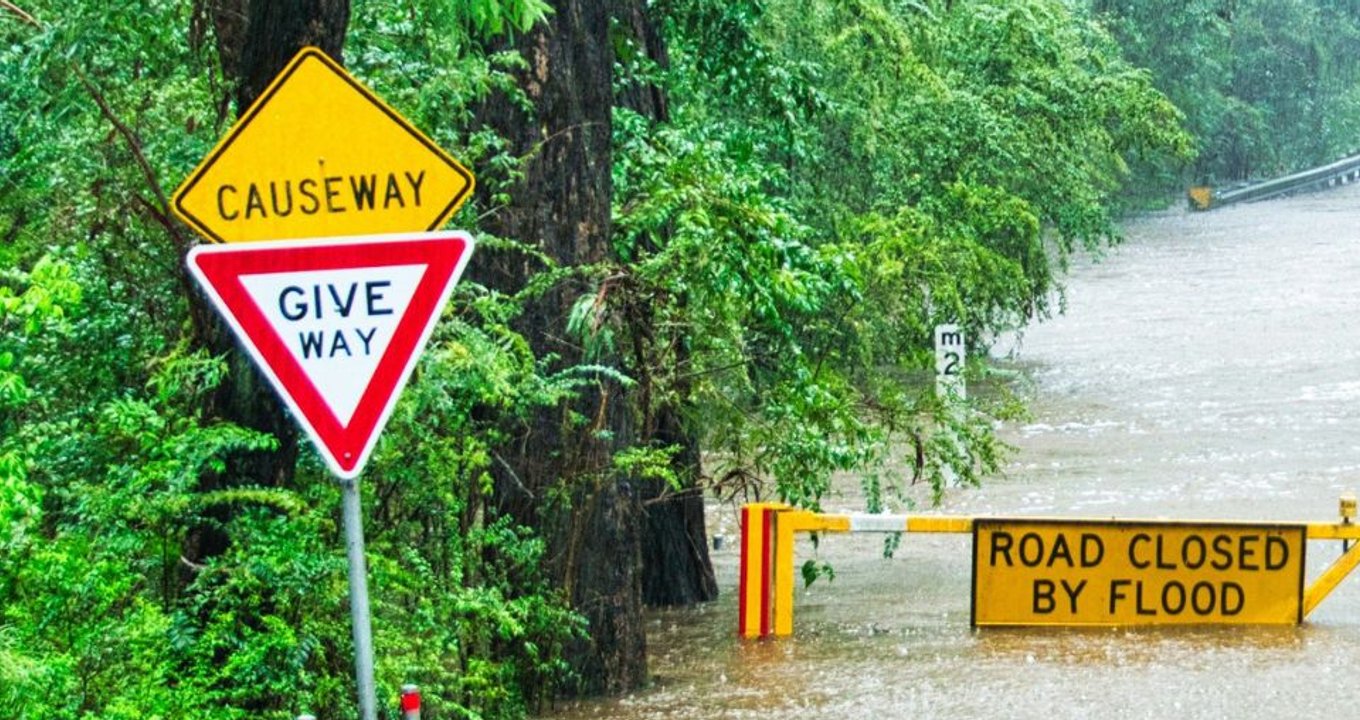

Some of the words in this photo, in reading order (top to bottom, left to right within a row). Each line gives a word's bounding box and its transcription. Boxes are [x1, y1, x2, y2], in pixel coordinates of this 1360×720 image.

[217, 171, 426, 221] CAUSEWAY
[278, 281, 393, 321] GIVE
[299, 328, 377, 359] WAY
[944, 352, 960, 375] 2
[990, 531, 1104, 568] ROAD
[1128, 534, 1289, 571] CLOSED
[1032, 579, 1087, 615] BY
[1109, 580, 1245, 616] FLOOD
